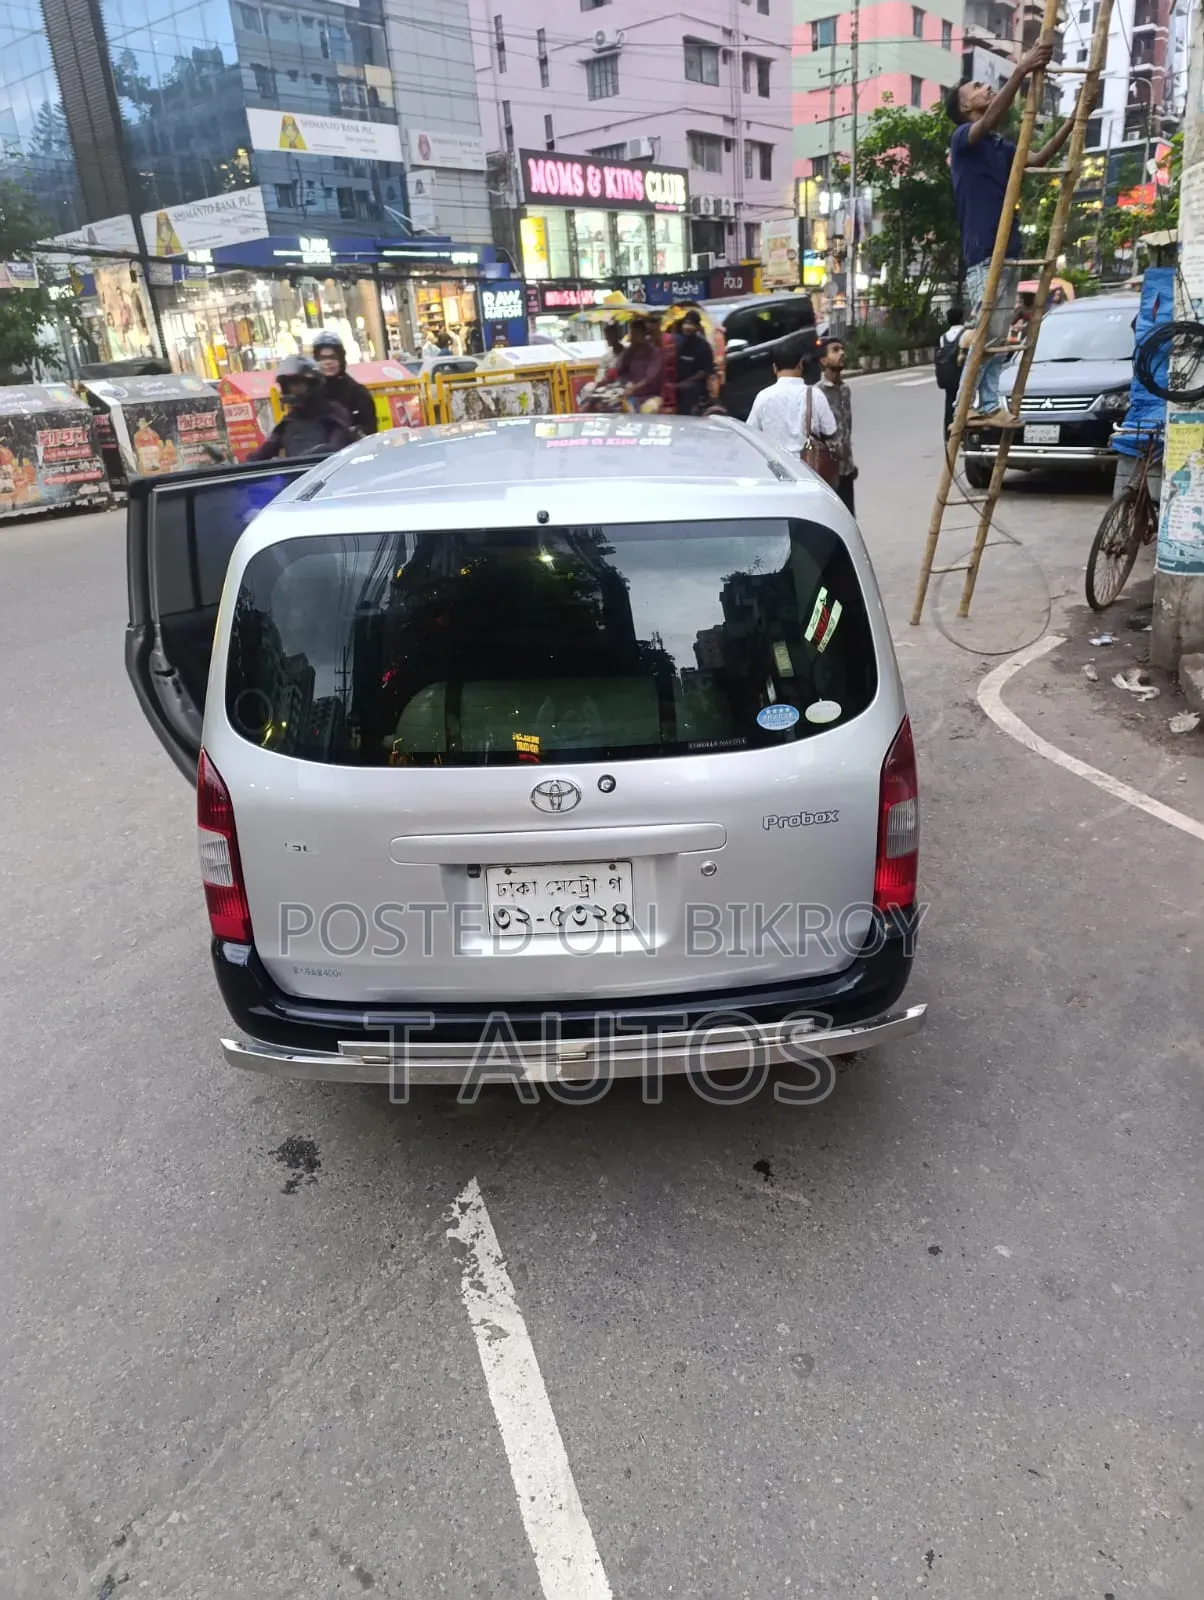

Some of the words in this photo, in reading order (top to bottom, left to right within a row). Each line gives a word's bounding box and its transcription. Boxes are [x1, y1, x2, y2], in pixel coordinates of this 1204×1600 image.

[528, 158, 584, 197] MOMS
[586, 164, 601, 198] &
[603, 165, 644, 201] KIDS
[645, 170, 686, 204] CLUB
[763, 810, 839, 830] Probox
[496, 880, 537, 897] ঢাকা
[545, 875, 597, 898] মেট্রো
[608, 876, 622, 894] গ
